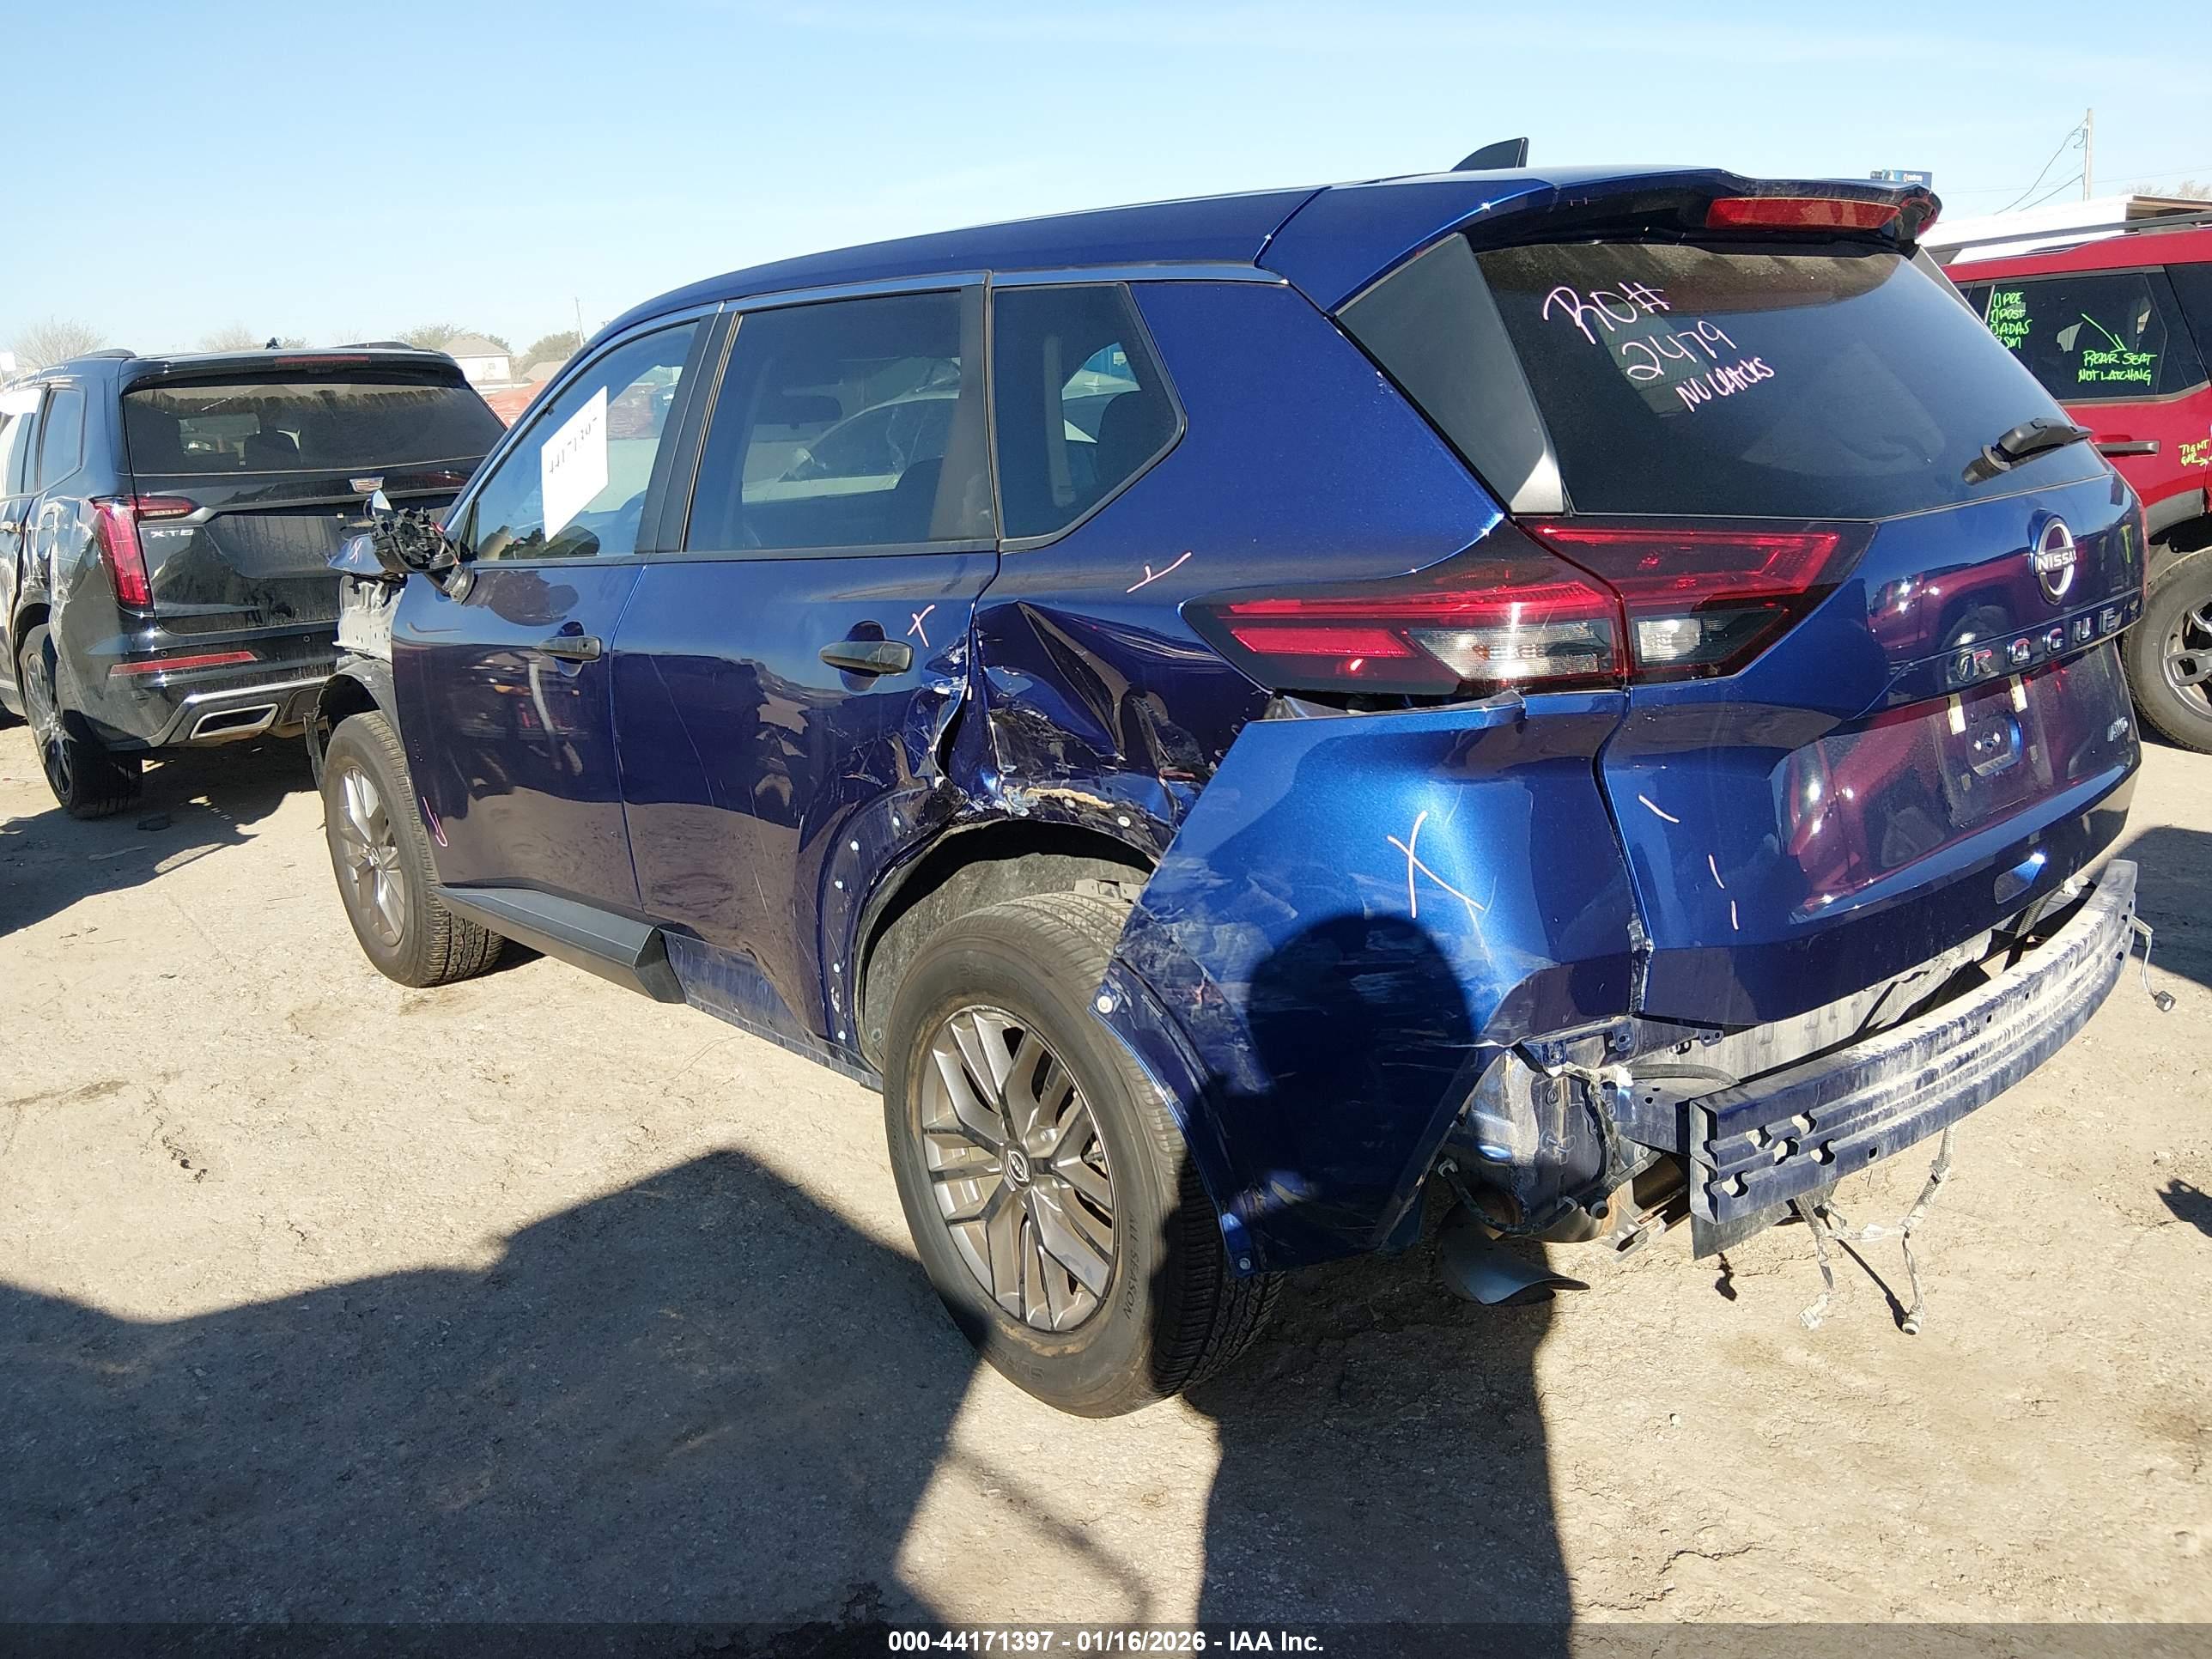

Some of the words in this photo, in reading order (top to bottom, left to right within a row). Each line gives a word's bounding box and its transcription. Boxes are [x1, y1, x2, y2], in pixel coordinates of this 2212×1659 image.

[1999, 308, 2027, 320] POST
[1999, 319, 2033, 336] ADAS
[1621, 319, 1738, 380] 2479
[2082, 349, 2120, 367] REAR
[2122, 352, 2158, 366] SEAT
[2077, 368, 2100, 383] NOT
[2100, 368, 2152, 386] LATCHING
[1675, 378, 1712, 412] NO
[2178, 439, 2210, 456] TIGHT
[1962, 606, 2118, 680] ROGUE
